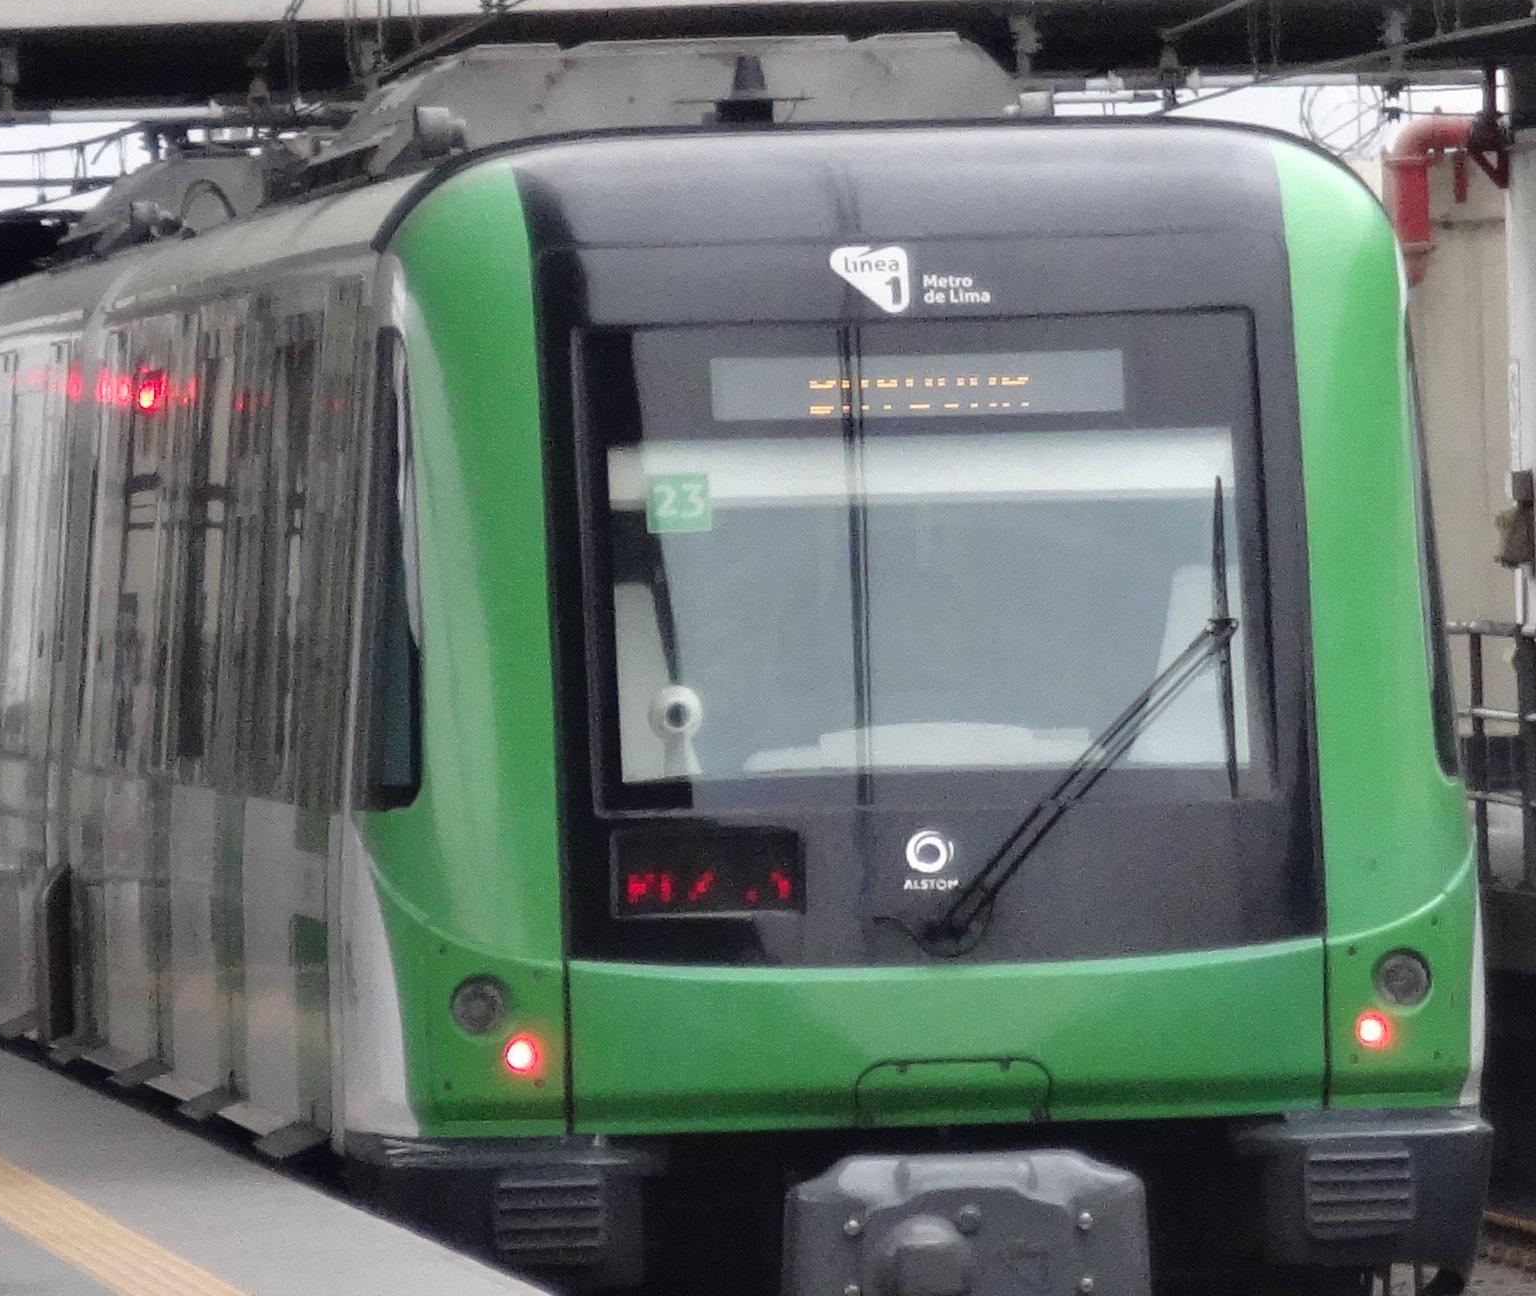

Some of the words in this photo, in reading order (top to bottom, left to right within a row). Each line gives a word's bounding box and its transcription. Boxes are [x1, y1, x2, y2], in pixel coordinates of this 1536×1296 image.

[885, 276, 902, 305] 1
[922, 274, 973, 288] Metro
[923, 290, 946, 304] de
[950, 290, 992, 304] Lima
[654, 483, 706, 519] 23
